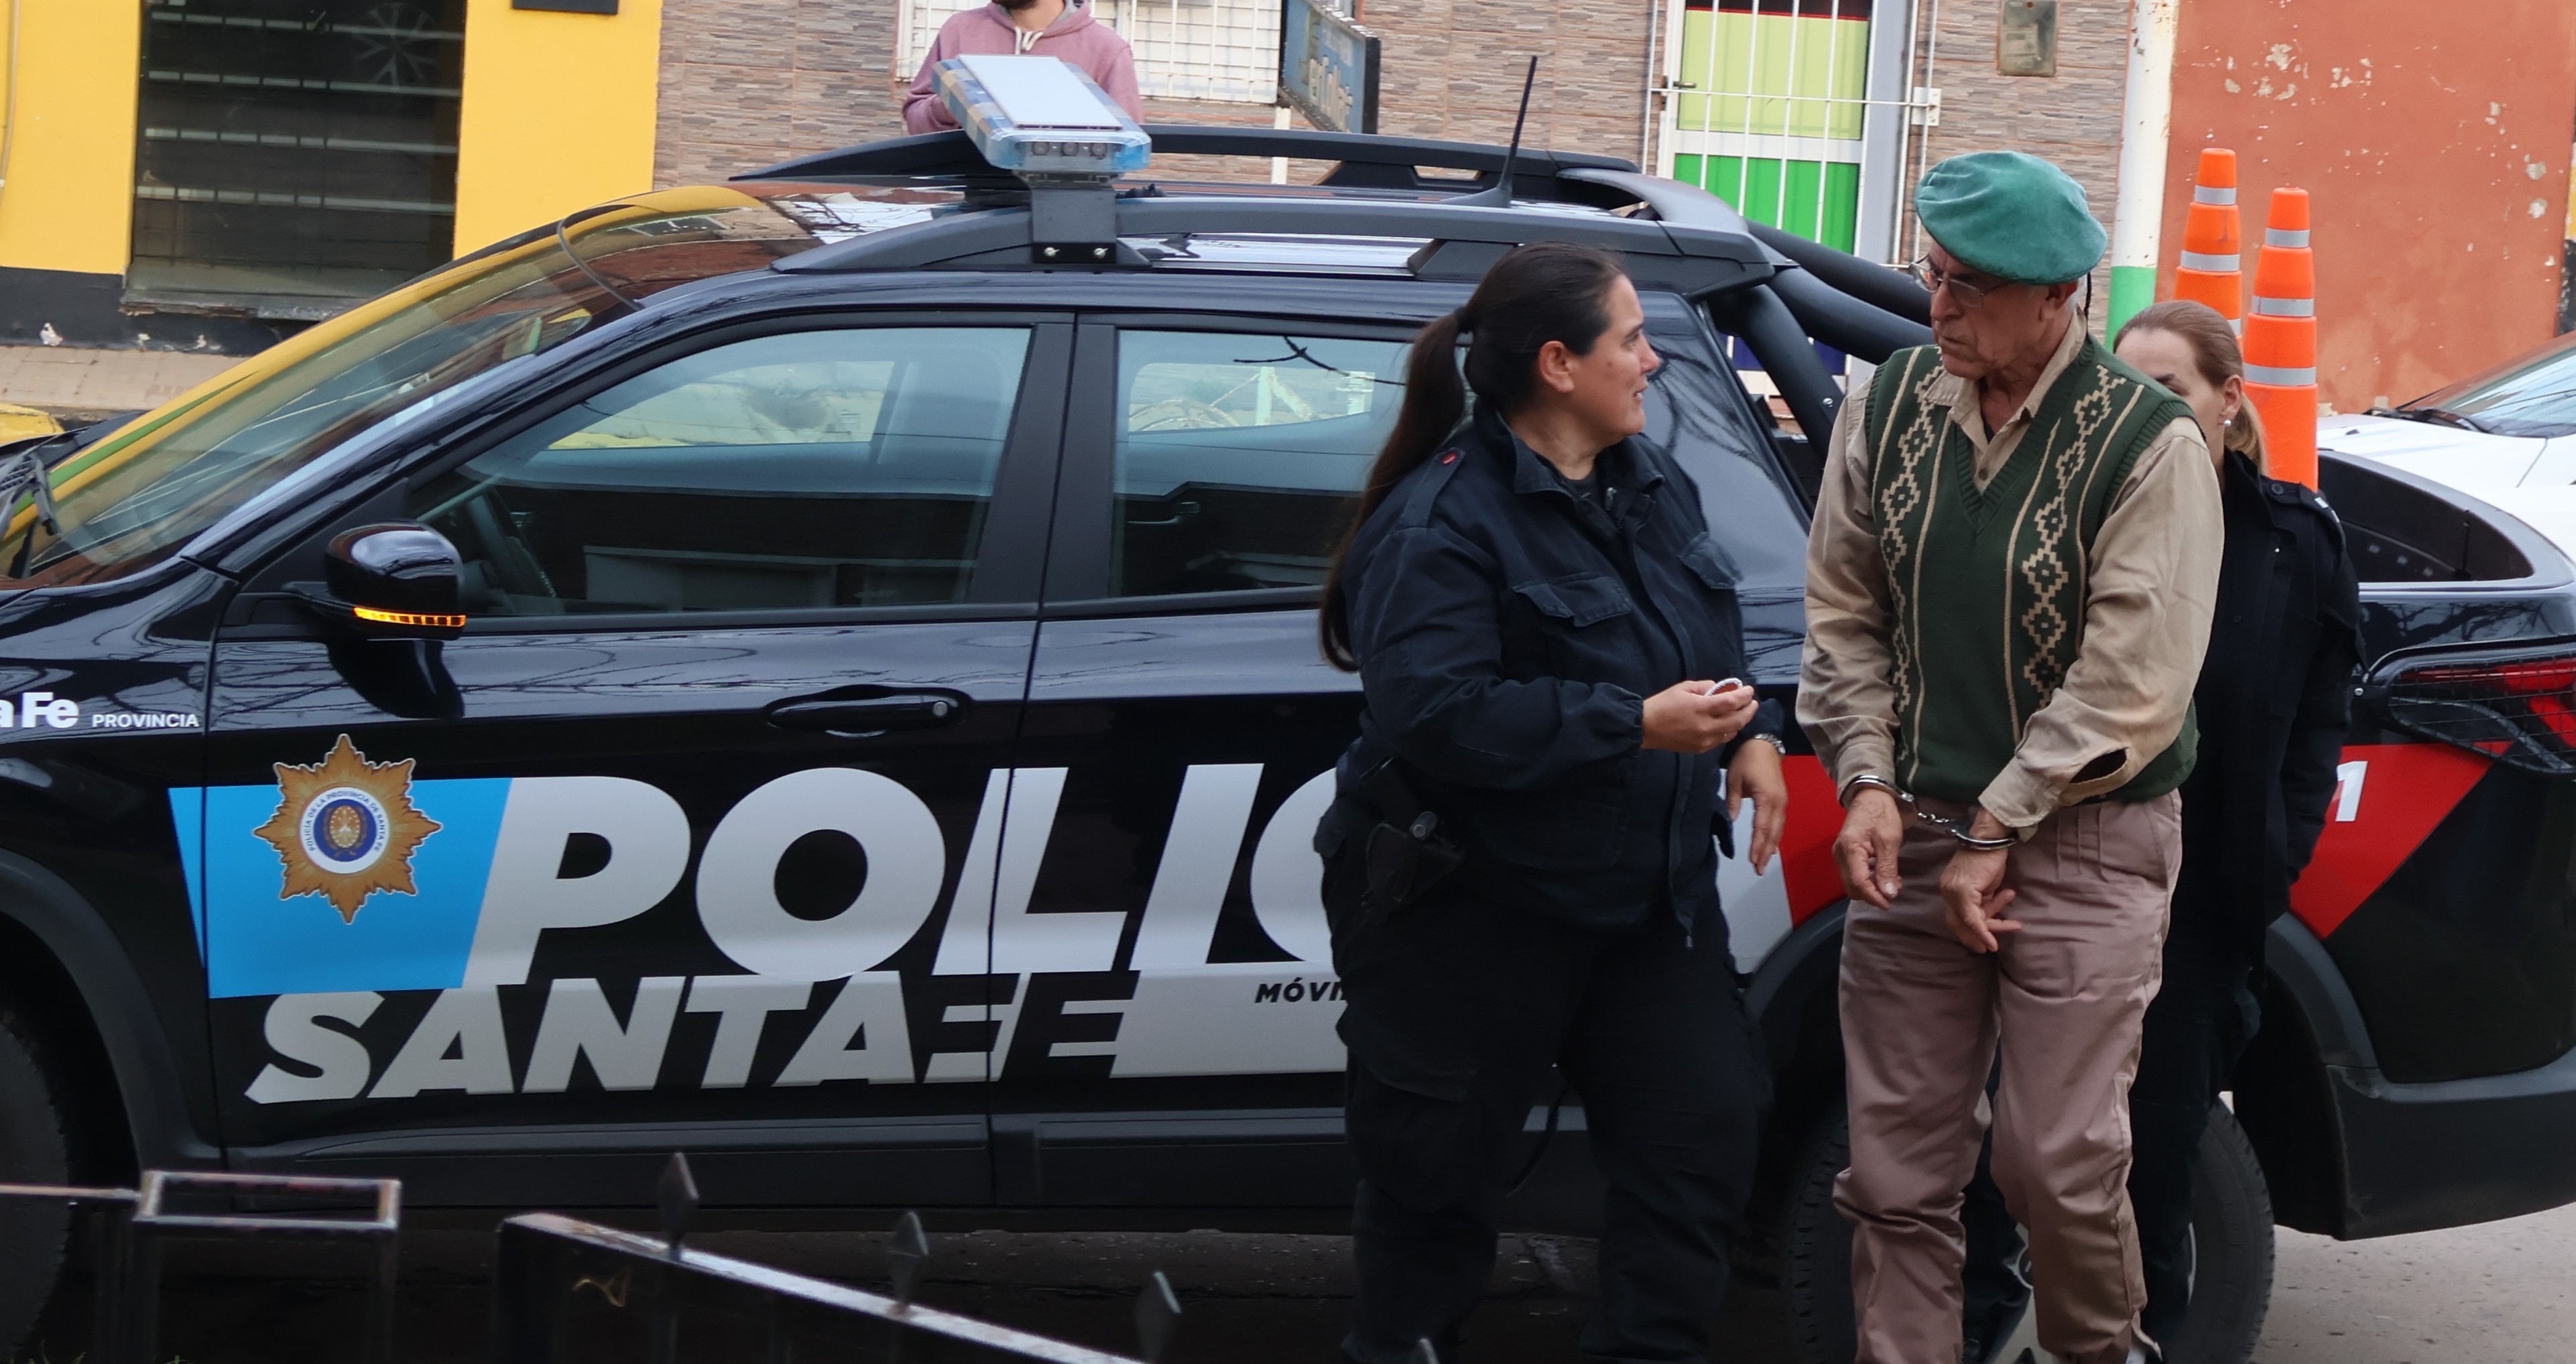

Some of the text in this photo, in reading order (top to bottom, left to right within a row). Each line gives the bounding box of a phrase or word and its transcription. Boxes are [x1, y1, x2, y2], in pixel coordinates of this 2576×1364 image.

[22, 692, 79, 728] Fe
[92, 714, 200, 727] PROVINCIA
[461, 763, 1337, 988] POLI
[1255, 977, 1346, 1003] MÓVI
[245, 970, 916, 1104] SANTA
